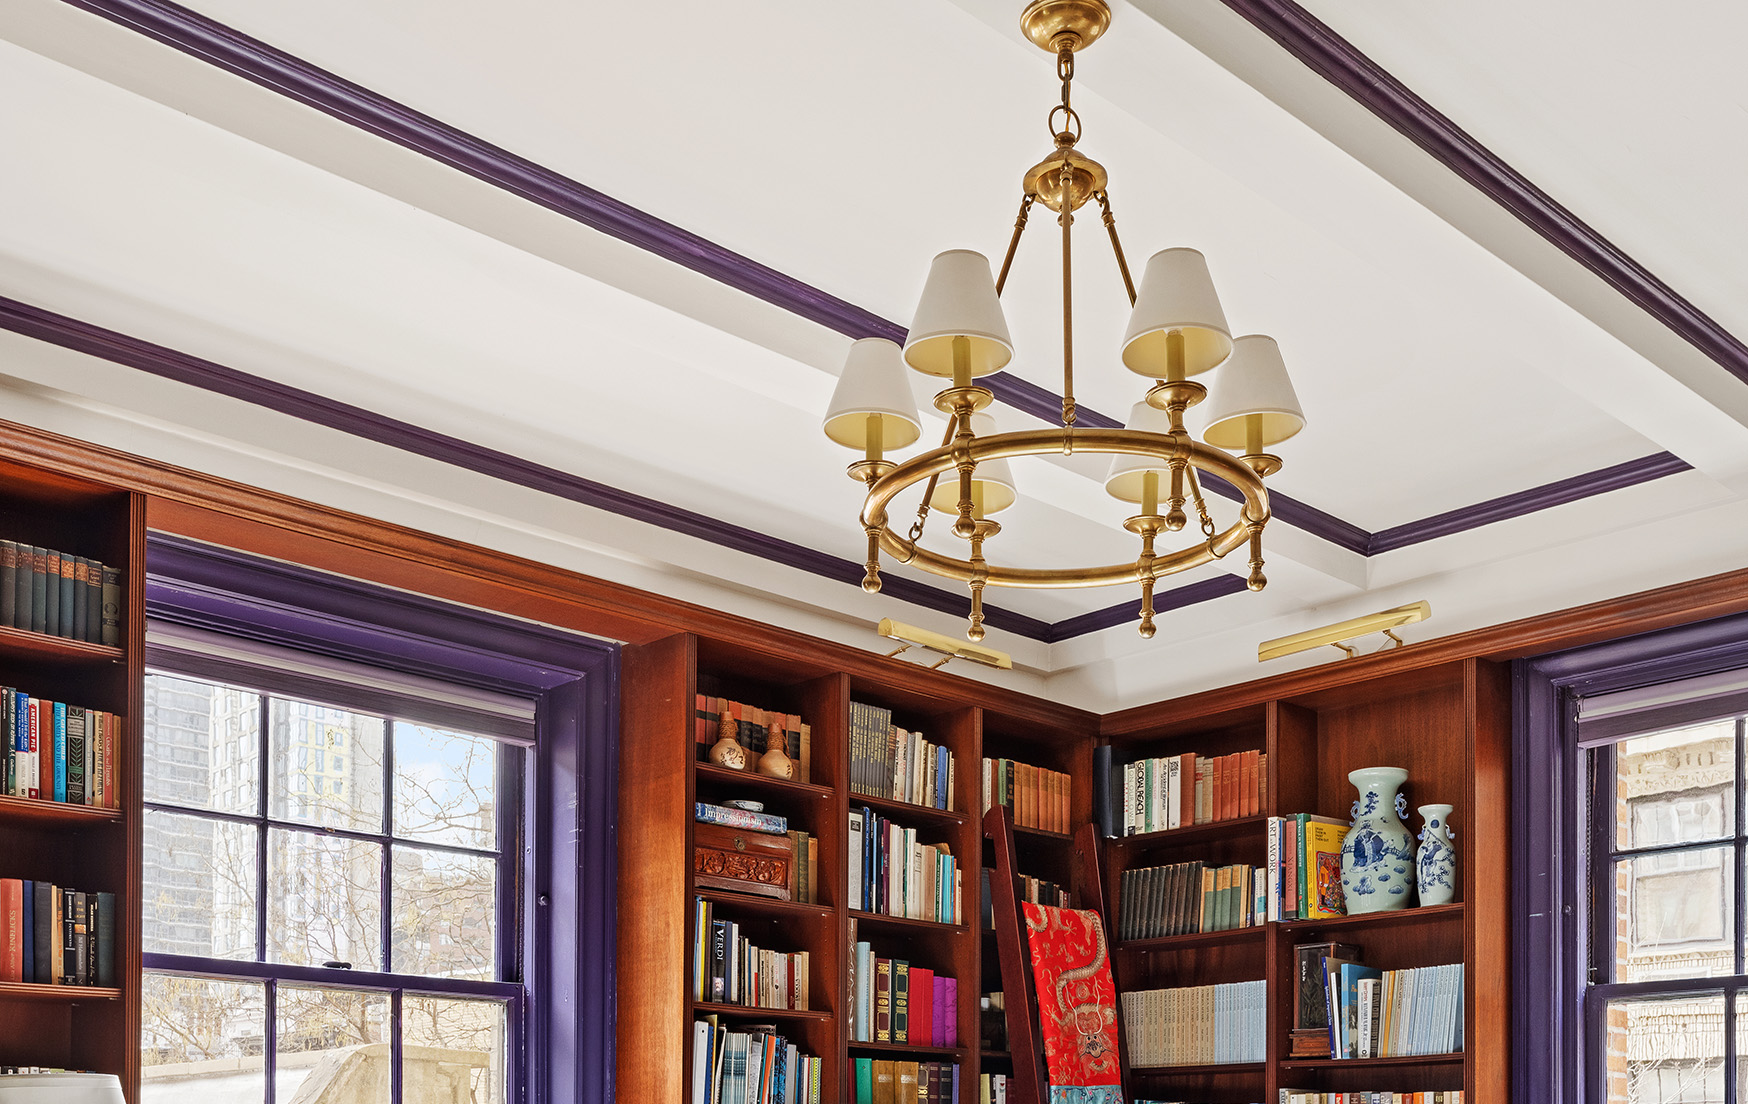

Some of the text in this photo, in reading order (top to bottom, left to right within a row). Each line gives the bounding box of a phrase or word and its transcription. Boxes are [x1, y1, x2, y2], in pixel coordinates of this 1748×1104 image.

[1128, 770, 1134, 782] ON
[1136, 790, 1144, 815] REACH
[704, 807, 762, 826] Impressionism
